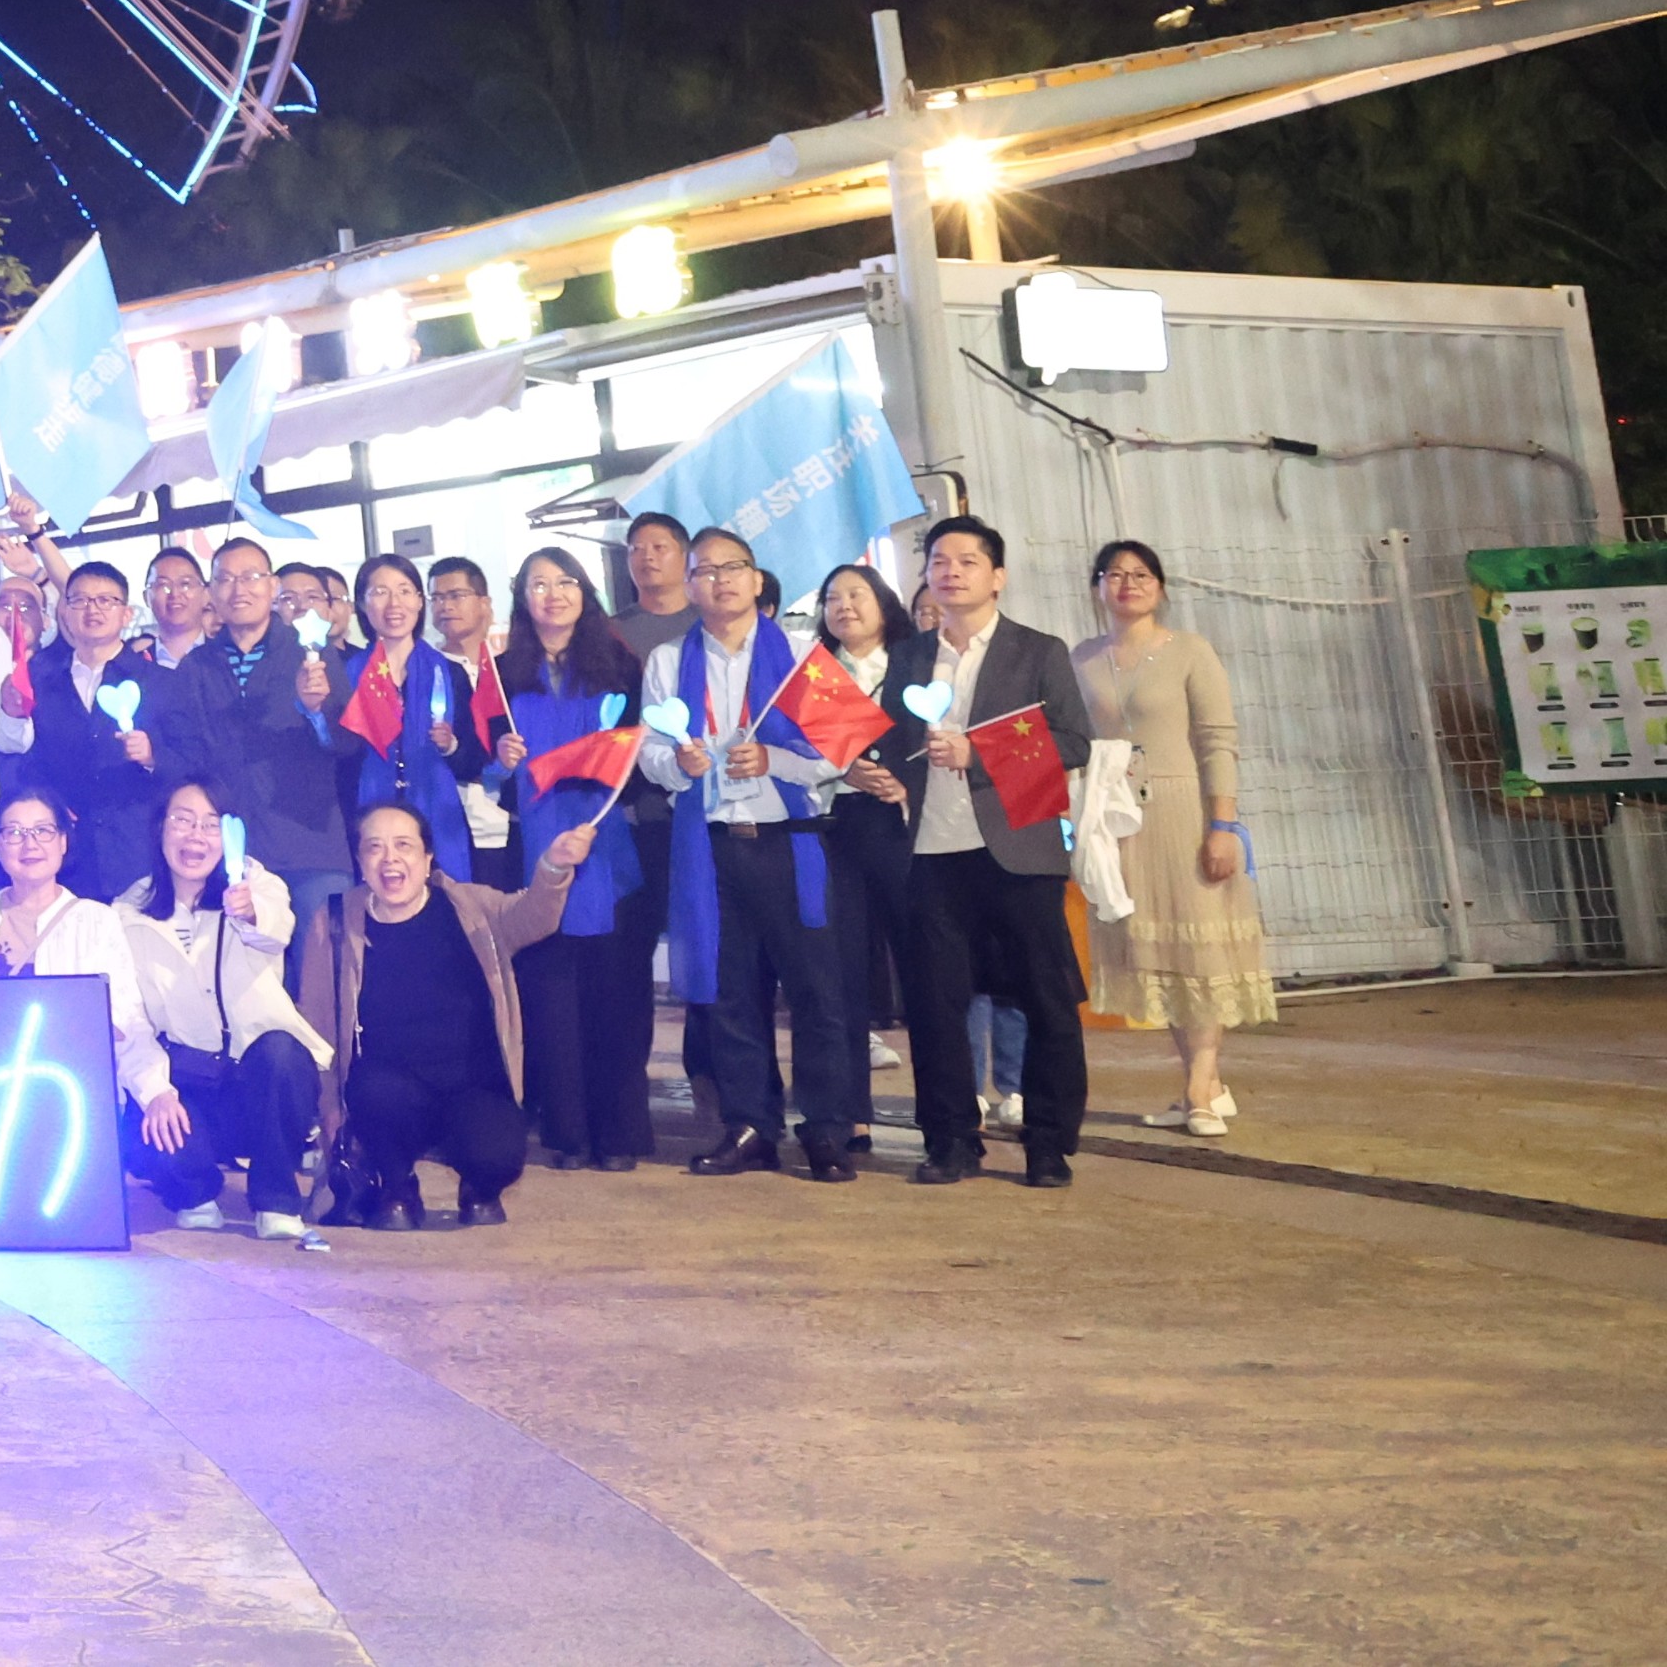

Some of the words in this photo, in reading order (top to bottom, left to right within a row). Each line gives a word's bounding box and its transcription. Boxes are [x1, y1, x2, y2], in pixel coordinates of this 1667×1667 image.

[720, 415, 880, 541] 关注职场糖
